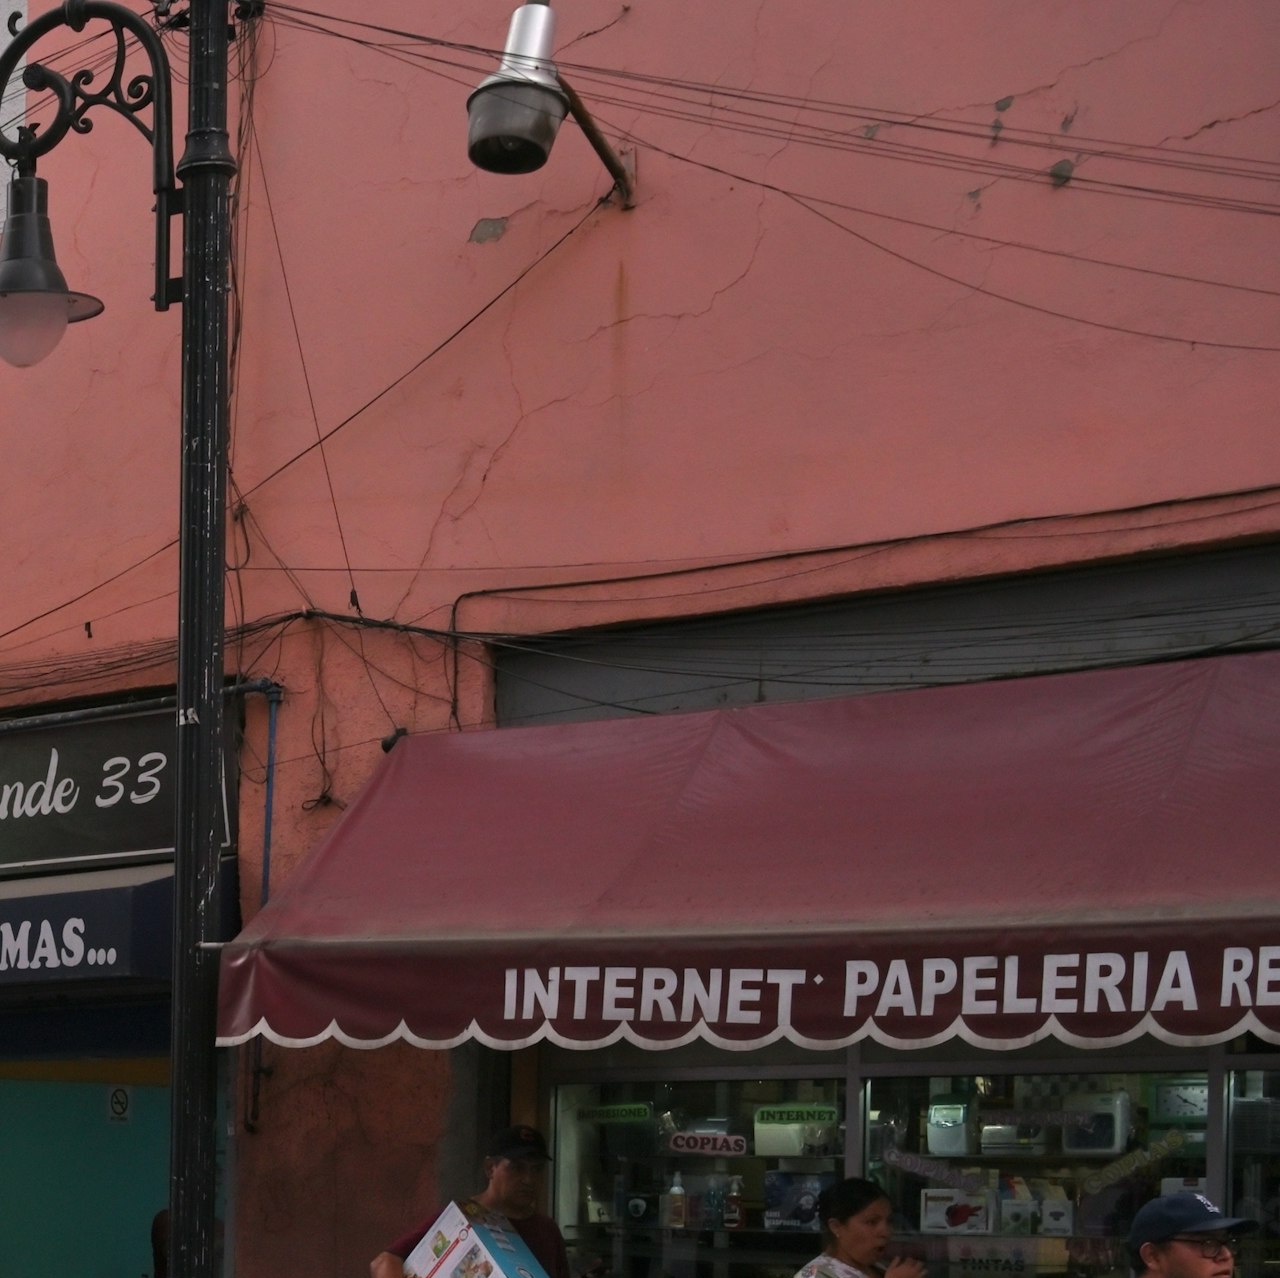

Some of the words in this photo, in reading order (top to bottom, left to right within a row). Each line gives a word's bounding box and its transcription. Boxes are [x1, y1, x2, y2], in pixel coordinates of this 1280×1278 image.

[95, 752, 167, 808] 33
[503, 965, 807, 1026] INTERNET
[842, 949, 1199, 1017] PAPELERIA
[760, 1109, 837, 1122] INTERNET
[671, 1135, 746, 1153] COPIAS
[959, 1258, 1025, 1272] TINTAS
